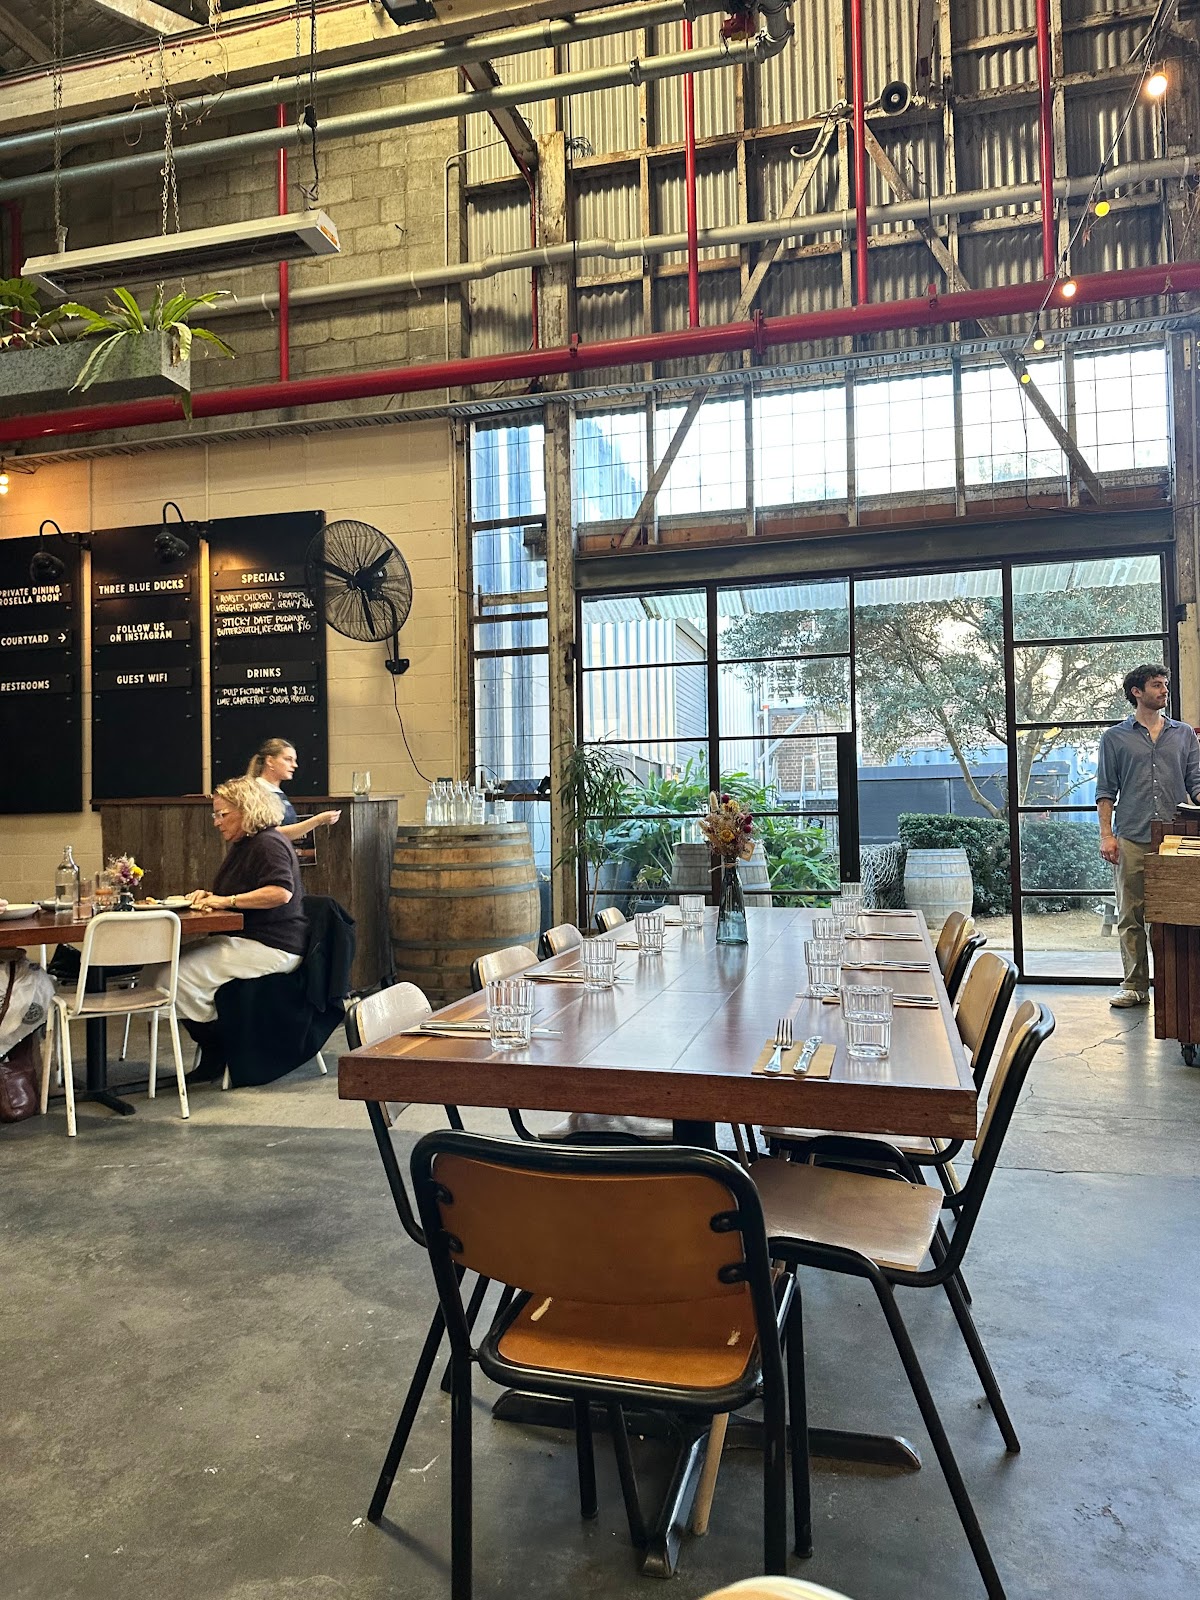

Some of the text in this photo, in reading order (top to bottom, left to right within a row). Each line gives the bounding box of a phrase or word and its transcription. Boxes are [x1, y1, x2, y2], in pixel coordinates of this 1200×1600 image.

[241, 572, 285, 584] SPECIALS
[32, 585, 60, 595] DINING
[99, 579, 184, 594] THREE BLUE DUCKS
[277, 599, 300, 609] GRAVY
[222, 616, 250, 628] STICKY
[253, 615, 273, 625] DATE
[297, 620, 311, 633] $16
[117, 622, 165, 633] FOLLOW US
[1, 634, 49, 646] COURTYARD
[110, 630, 172, 642] ON INSTAGRAM
[246, 667, 281, 678] DRINKS
[117, 673, 168, 684] GUEST WIFI
[1, 680, 50, 691] RESTROOMS
[272, 686, 288, 695] RUM
[292, 685, 306, 696] $21
